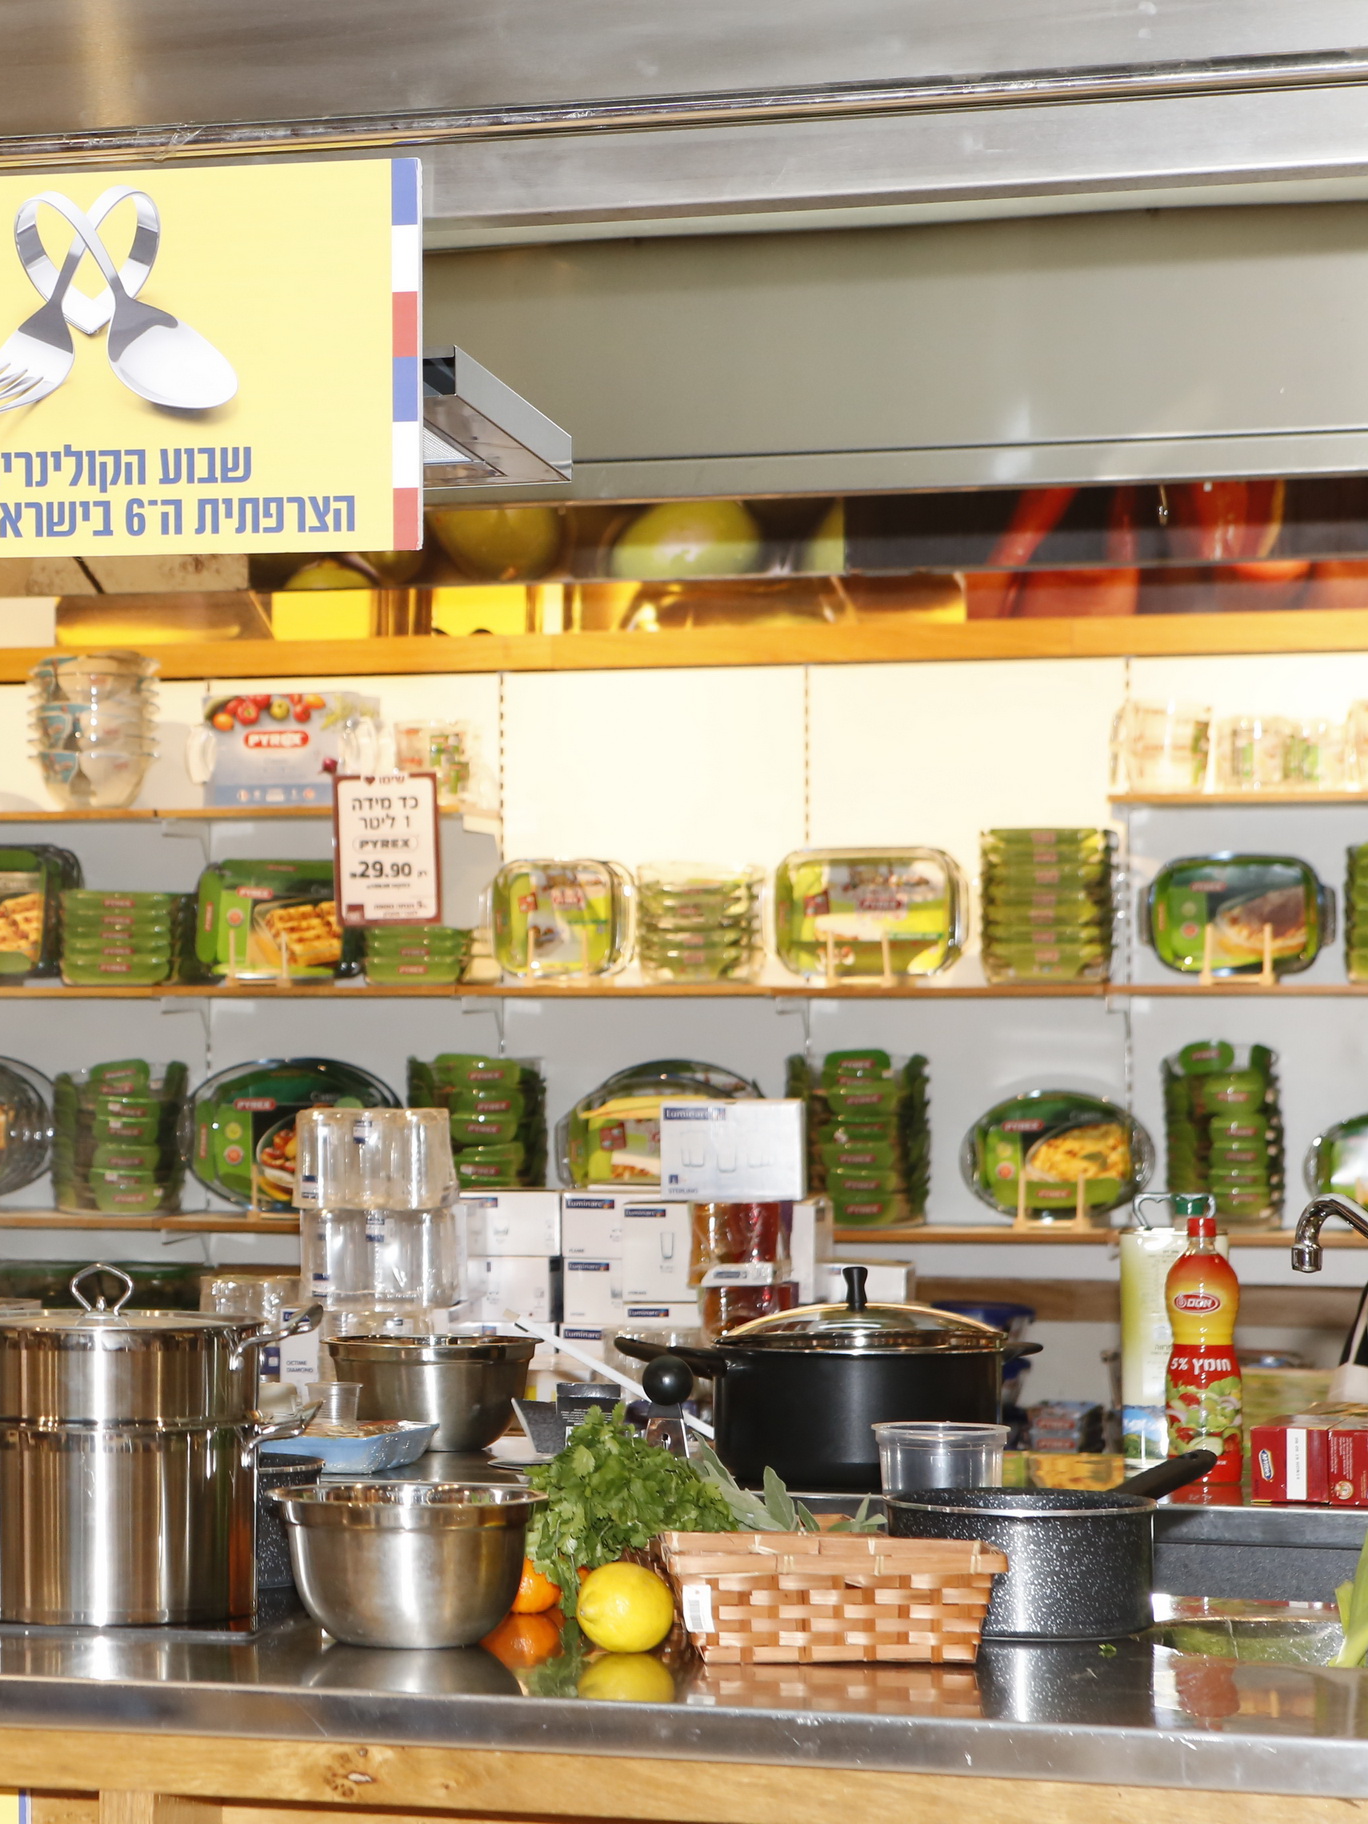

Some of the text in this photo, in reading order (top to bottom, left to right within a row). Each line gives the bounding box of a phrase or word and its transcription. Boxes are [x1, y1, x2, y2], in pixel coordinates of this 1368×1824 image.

[159, 445, 252, 484] שבוע
[195, 495, 356, 536] הצרפתית
[352, 796, 419, 811] כד מידה
[358, 813, 396, 830] ליטר
[359, 838, 410, 849] PYREX
[1170, 1357, 1231, 1375] חומץ 5%
